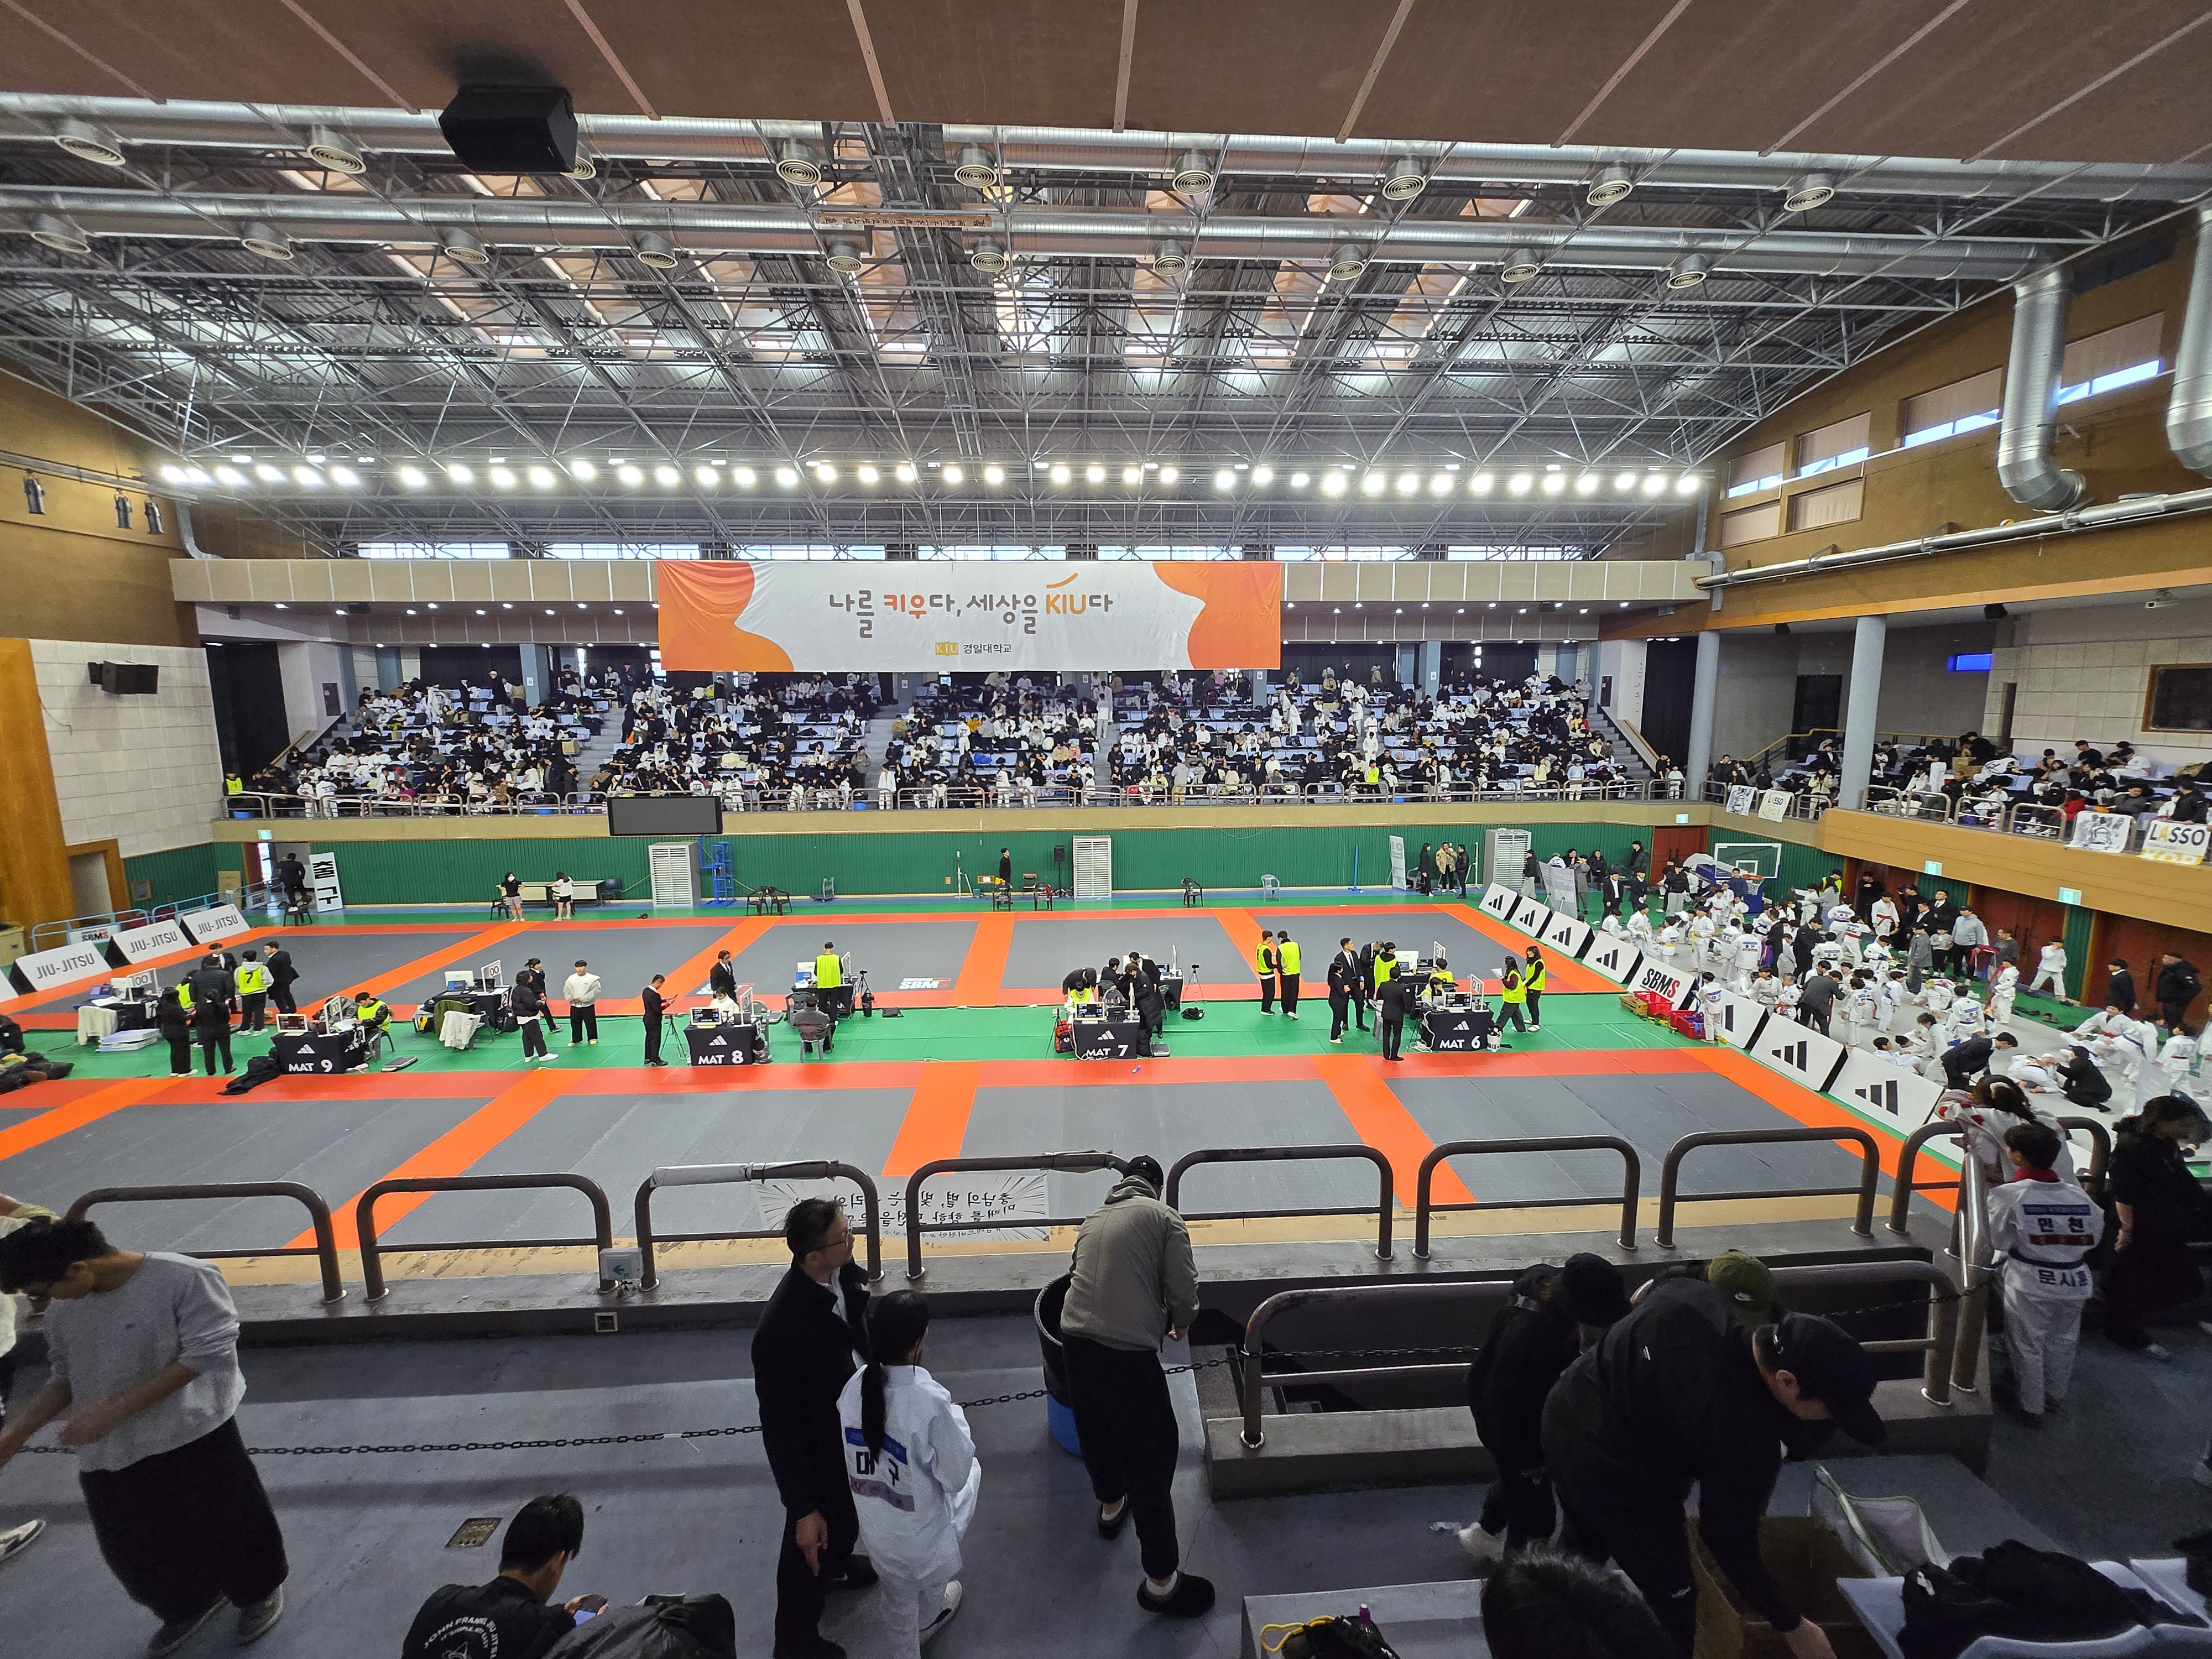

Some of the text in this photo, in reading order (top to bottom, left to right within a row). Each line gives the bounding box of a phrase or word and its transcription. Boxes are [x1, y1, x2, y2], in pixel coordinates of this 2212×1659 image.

[829, 589, 1113, 639] 나를 키우다, 세상을 KIU다
[935, 644, 958, 654] KIU
[963, 643, 1012, 654] 경일대학교
[2149, 823, 2205, 846] LASSO
[312, 860, 338, 905] 출구
[197, 914, 239, 935] JIU-JITSU
[82, 931, 109, 942] SBMS
[130, 931, 179, 954] JIU-JITSU
[36, 953, 96, 979] JIU-JITSU
[245, 972, 254, 984] 7
[1641, 968, 1681, 998] SBMS
[1439, 1039, 1465, 1048] MAT
[1471, 1035, 1481, 1048] 6
[698, 1050, 744, 1065] MAT 8
[1087, 1045, 1129, 1057] MAT 7
[288, 1059, 333, 1072] MAT 9
[424, 1621, 454, 1649] JOHN
[487, 1620, 497, 1633] JIU
